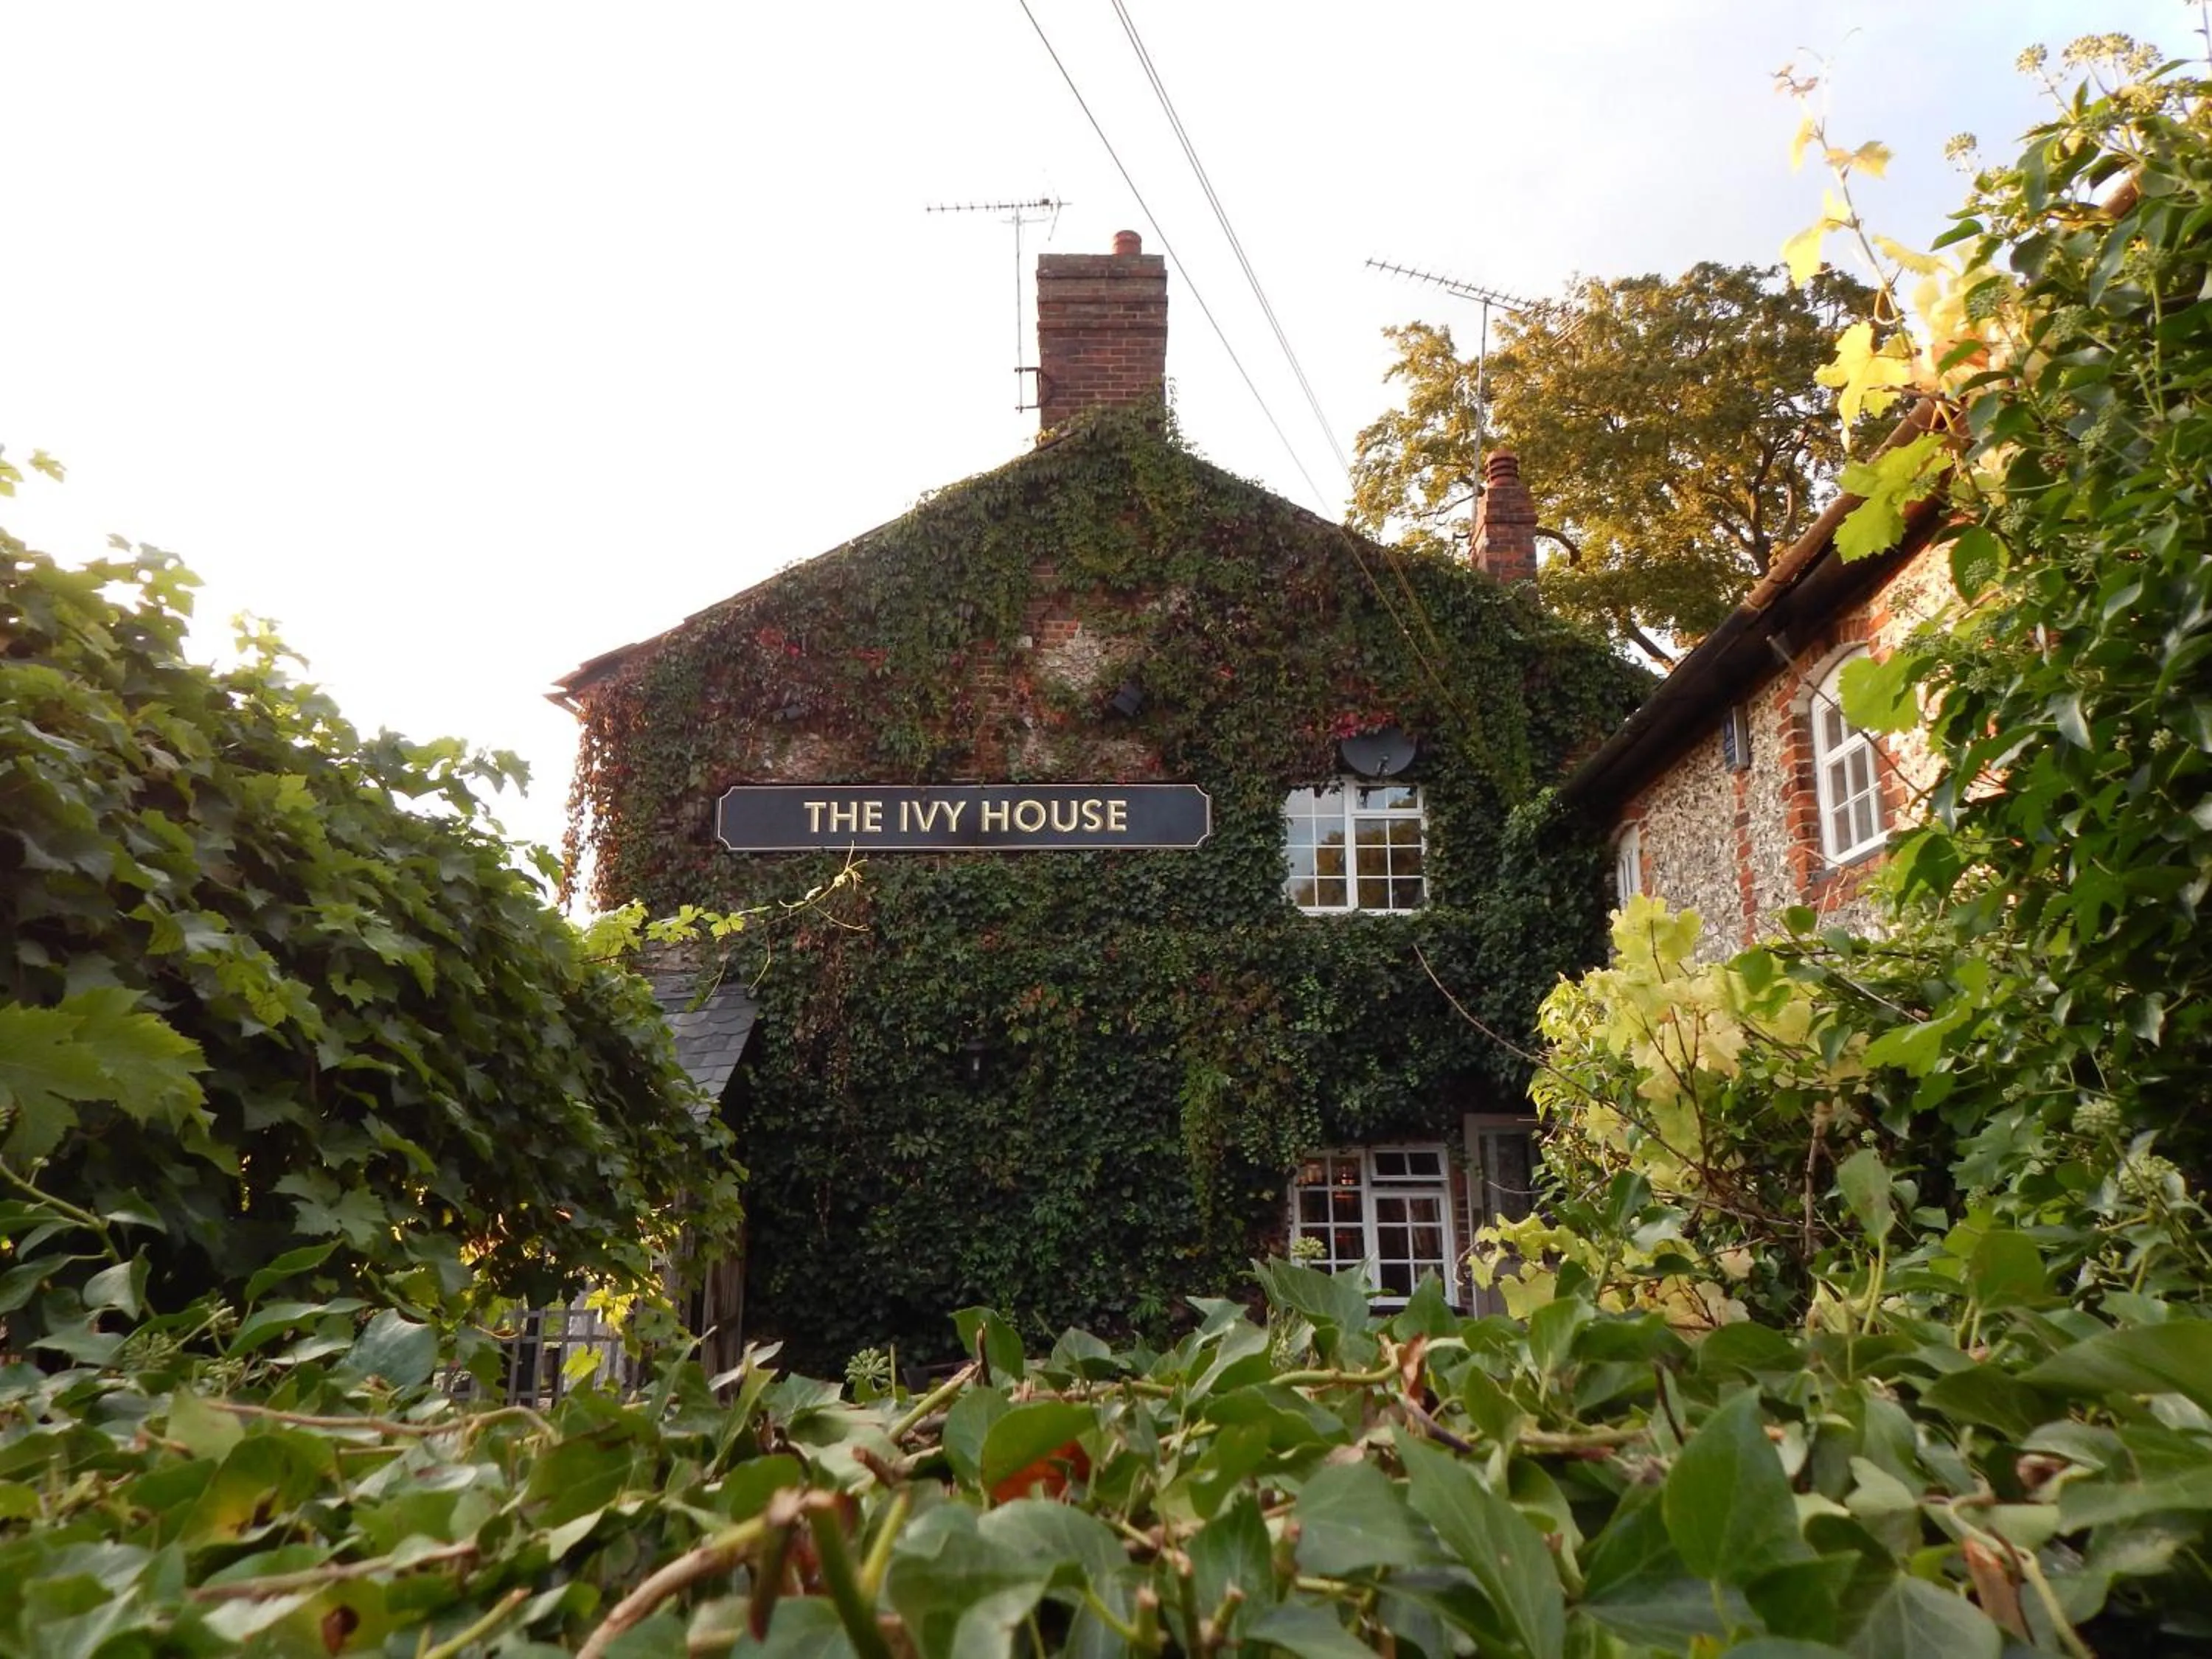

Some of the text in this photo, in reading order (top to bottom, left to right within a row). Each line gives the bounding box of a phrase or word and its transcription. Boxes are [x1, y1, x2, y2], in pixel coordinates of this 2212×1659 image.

[804, 799, 1127, 833] THE IVY HOUSE
